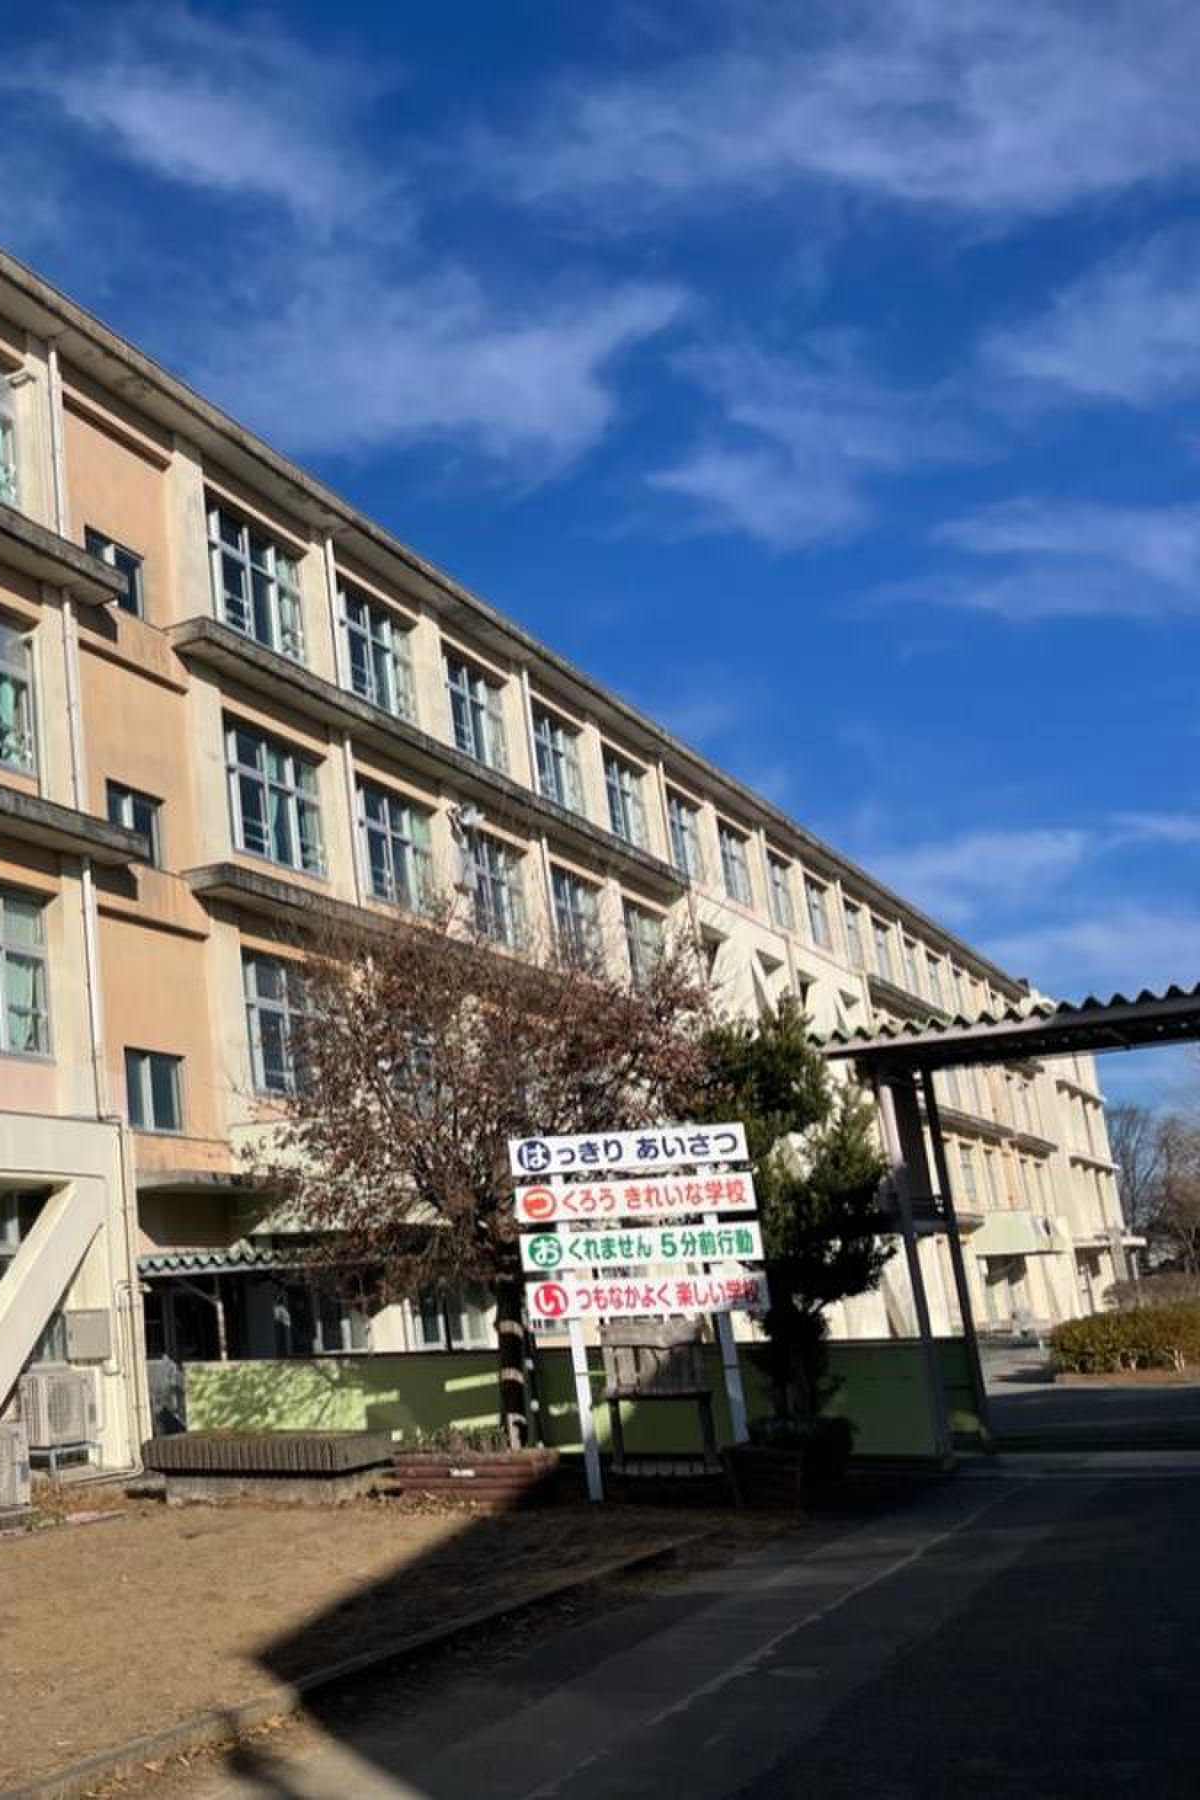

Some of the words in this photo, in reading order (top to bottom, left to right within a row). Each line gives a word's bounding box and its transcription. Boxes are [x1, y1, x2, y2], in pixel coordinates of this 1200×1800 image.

[517, 1139, 623, 1172] はっきり
[636, 1132, 738, 1159] あいさつ
[522, 1185, 616, 1219] つくろう
[624, 1179, 747, 1210] きれいな学校
[528, 1234, 651, 1268] おくれません
[661, 1229, 753, 1256] 5分前行動
[675, 1278, 760, 1306] 楽しい学校
